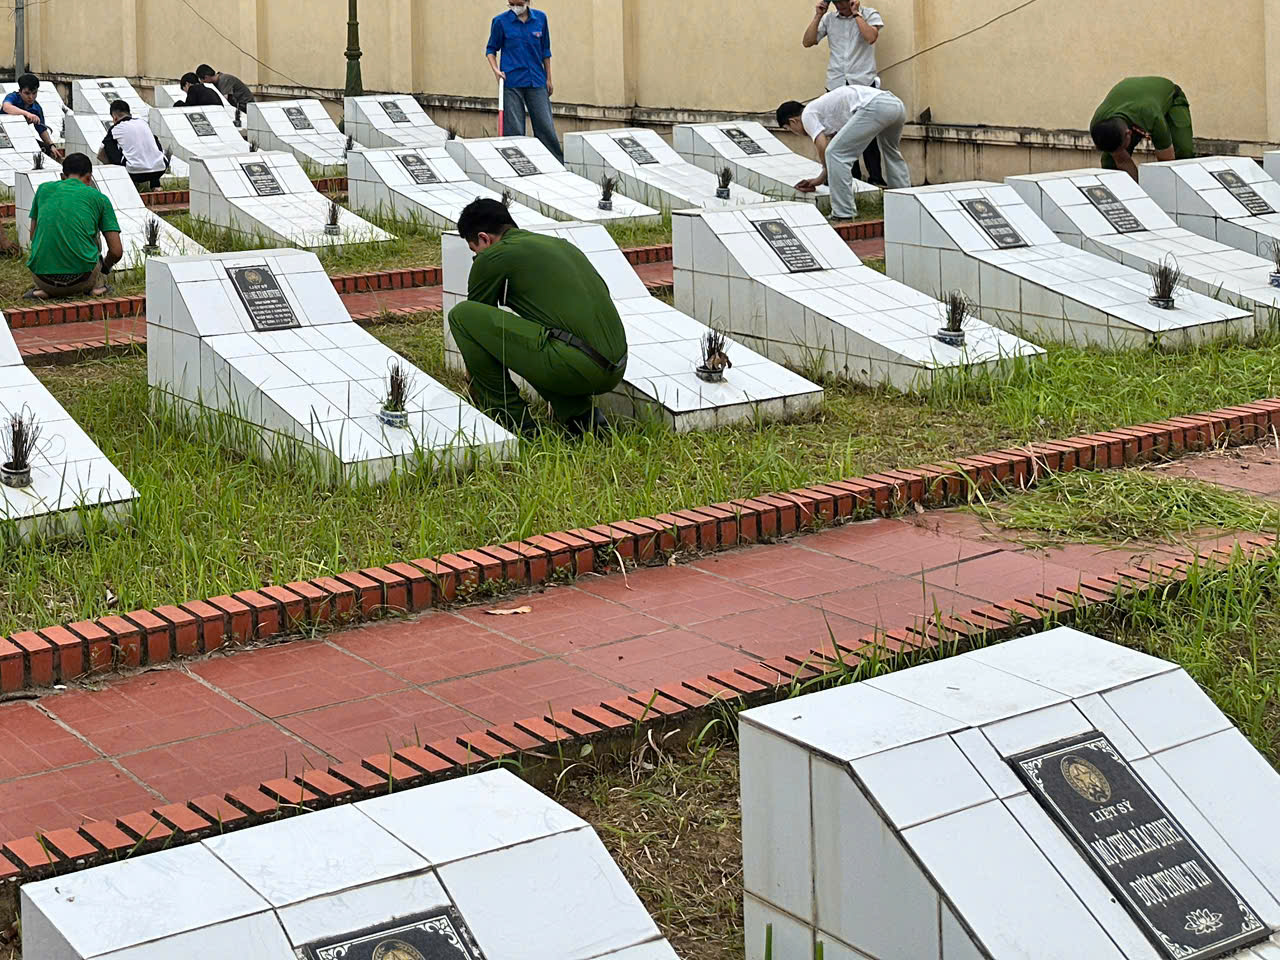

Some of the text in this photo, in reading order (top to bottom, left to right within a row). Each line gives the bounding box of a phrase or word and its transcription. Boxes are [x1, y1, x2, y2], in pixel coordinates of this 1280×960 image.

[1089, 805, 1118, 823] LIỆT
[1090, 818, 1183, 869] MỘ CHƯA XÁC ĐỊNH
[1129, 860, 1212, 908] ĐƯỢC THÔNG TIN
